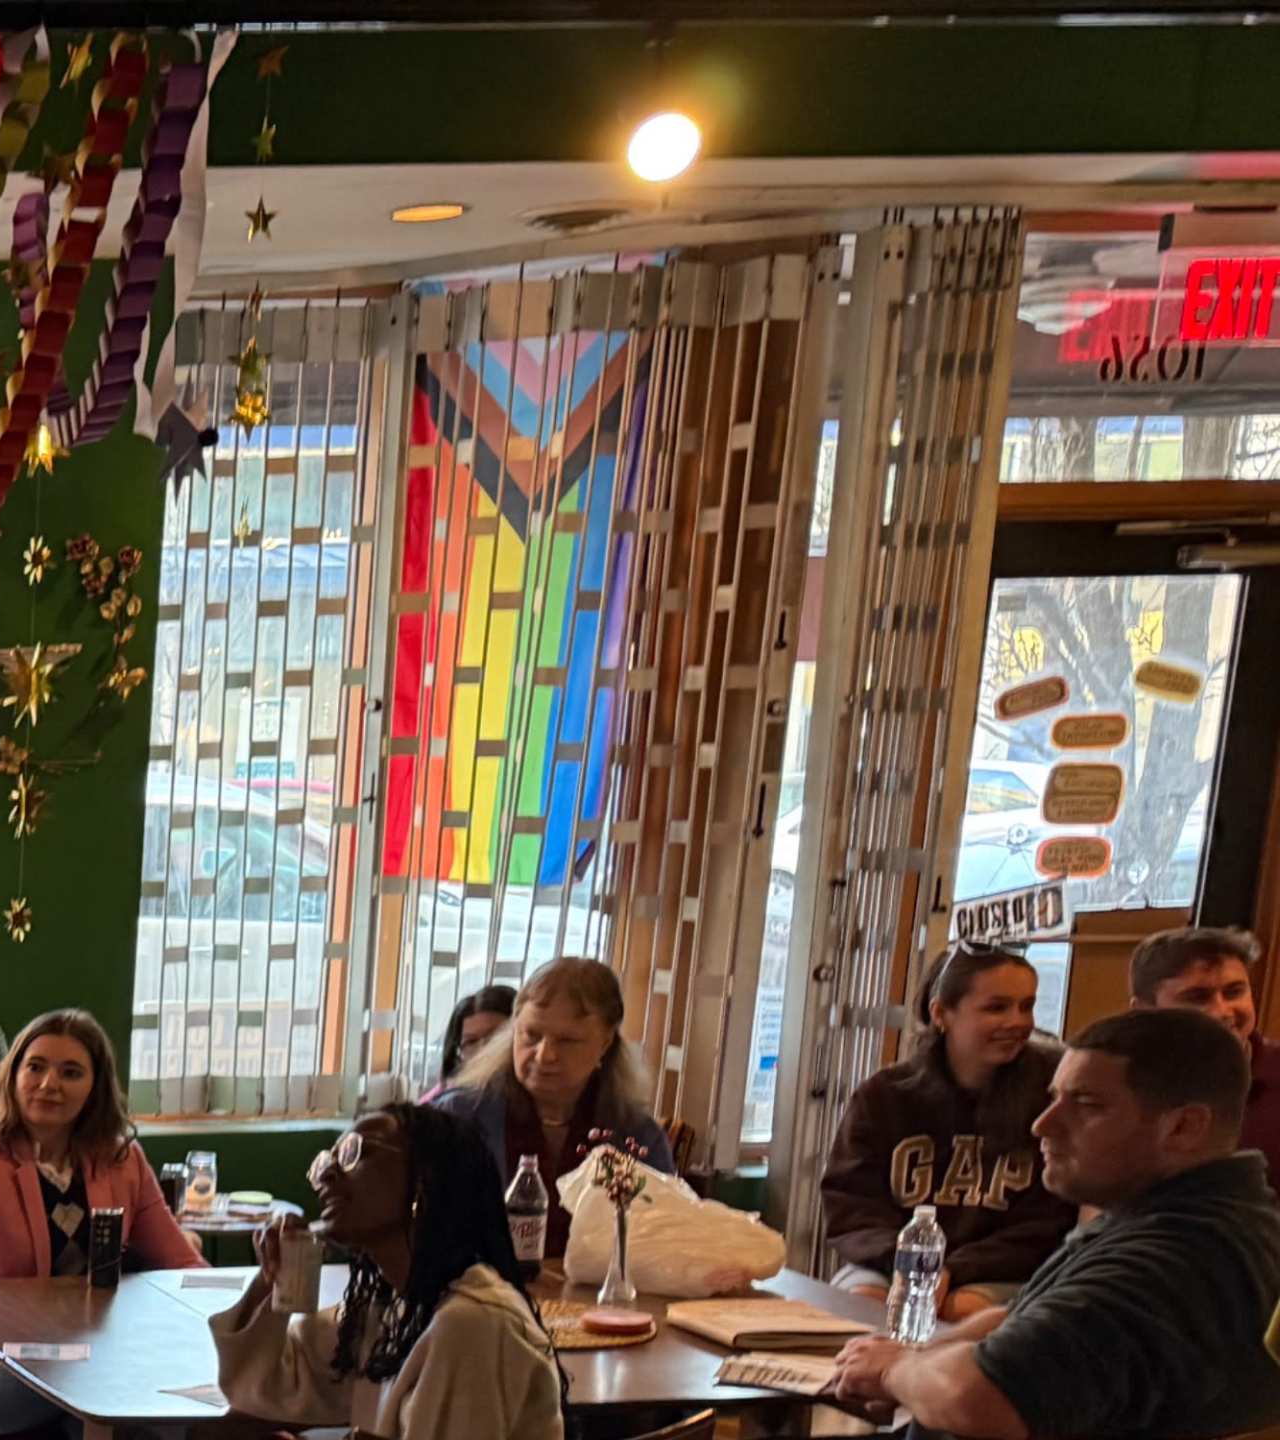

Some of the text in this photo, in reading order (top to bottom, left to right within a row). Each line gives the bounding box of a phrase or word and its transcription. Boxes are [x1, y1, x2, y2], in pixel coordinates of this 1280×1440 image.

[1181, 257, 1280, 340] EXIT
[957, 895, 1025, 938] CLOSED
[890, 1134, 1034, 1211] GAP
